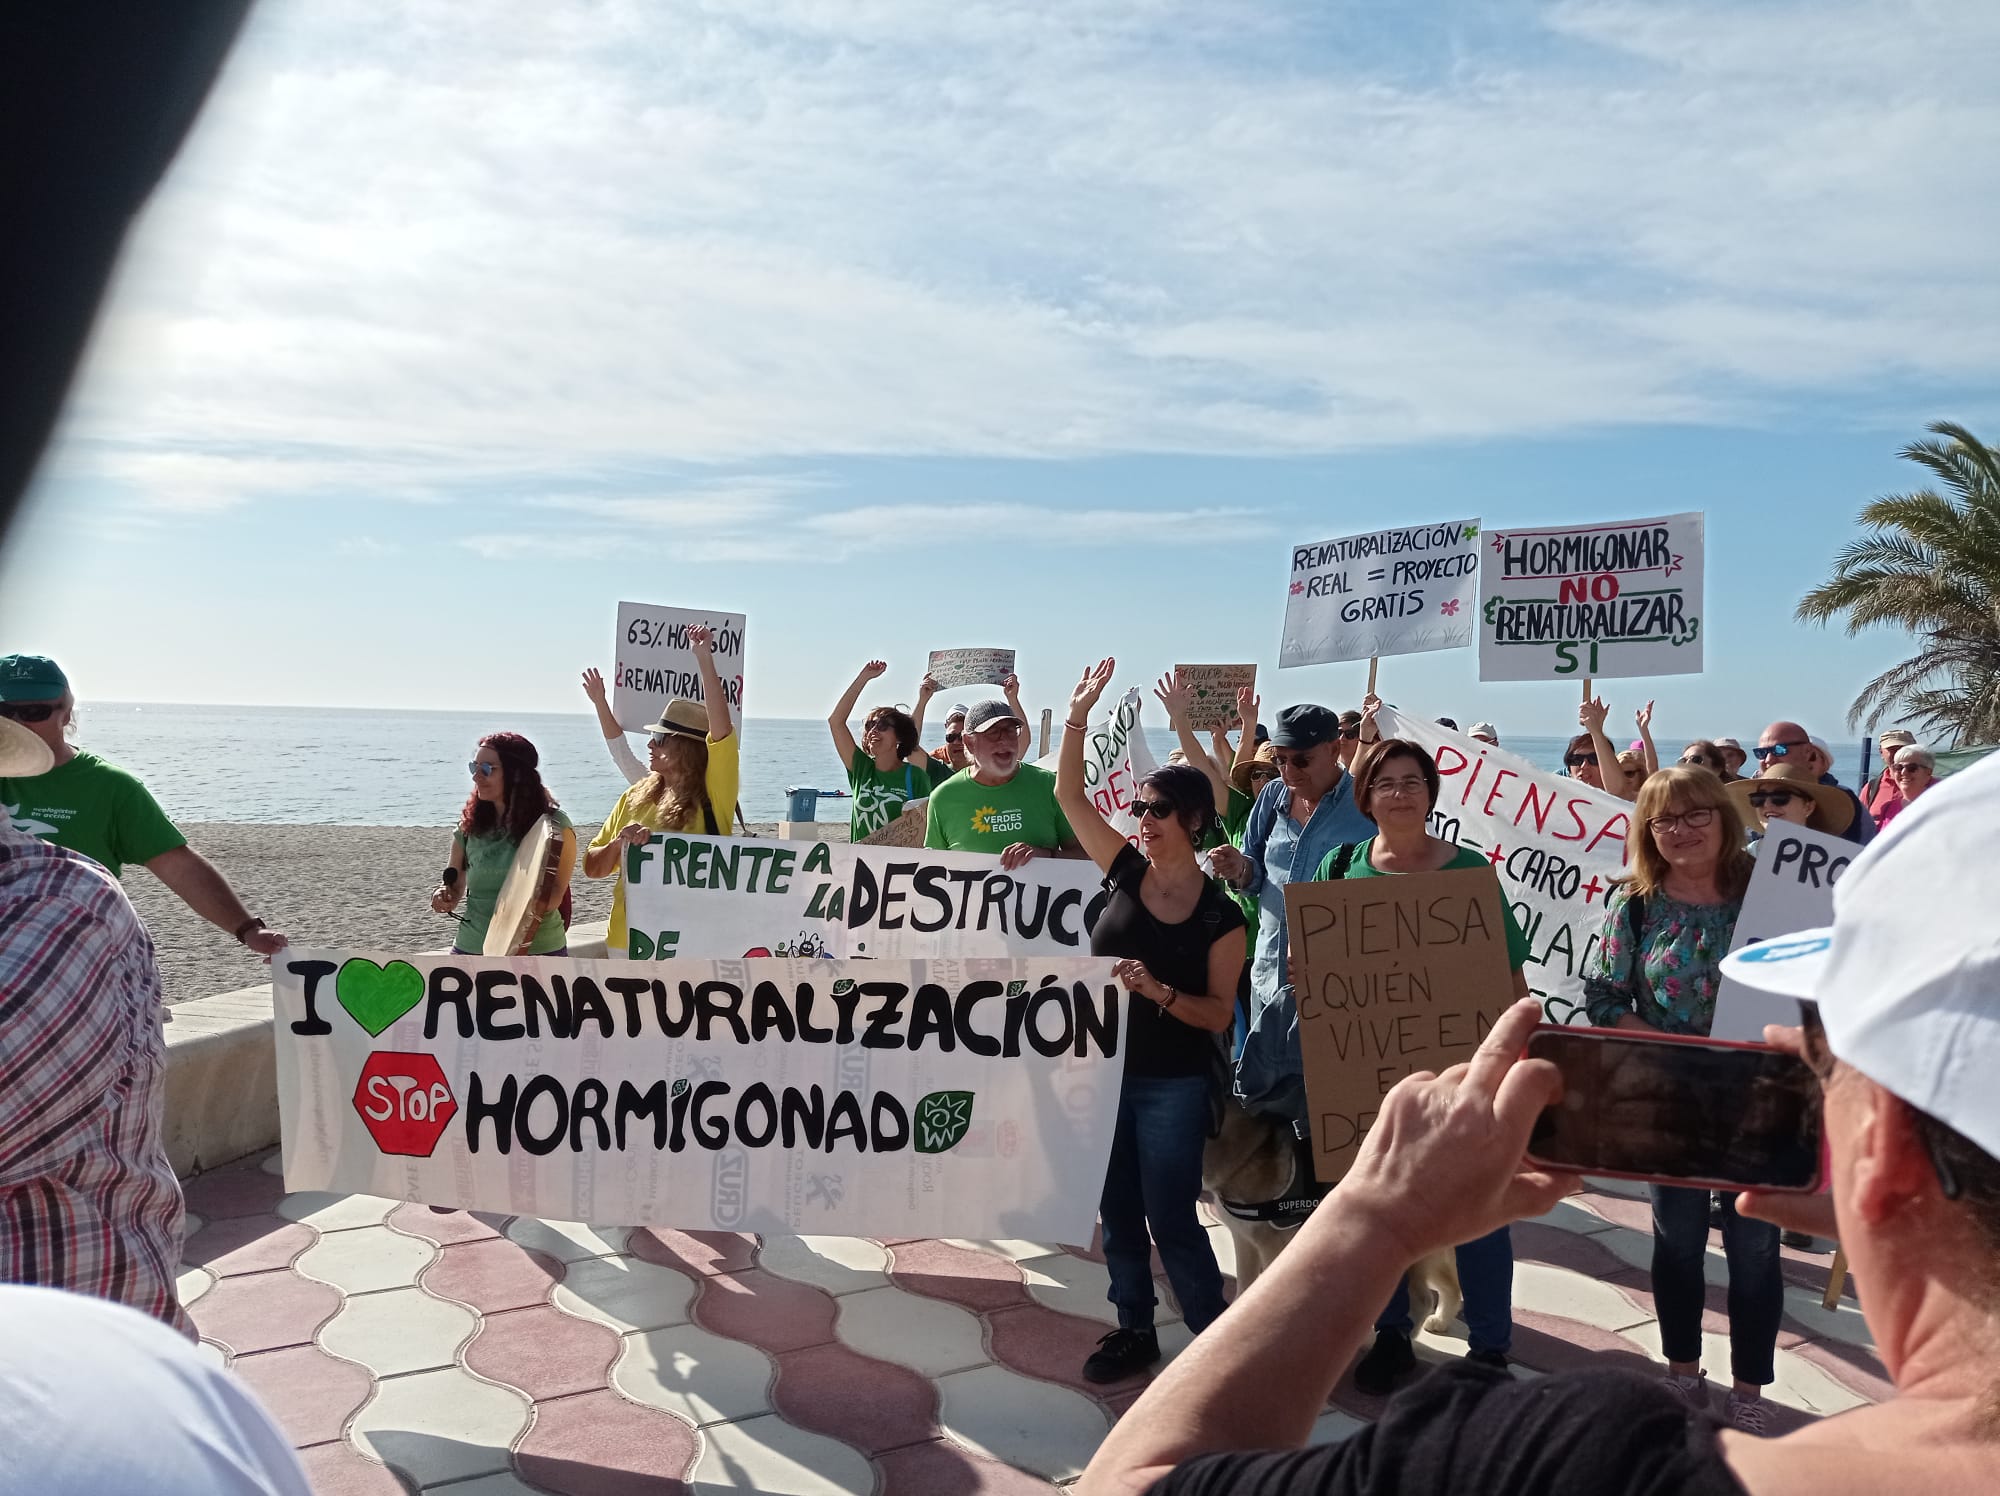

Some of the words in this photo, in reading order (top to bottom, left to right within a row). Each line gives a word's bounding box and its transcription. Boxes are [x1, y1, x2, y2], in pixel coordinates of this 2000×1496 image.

[1503, 528, 1671, 576] HORMIGONAR
[1307, 571, 1353, 598] REAL
[1392, 552, 1478, 586] PROYECTO
[1558, 573, 1620, 604] NO
[627, 619, 666, 648] 63%
[1495, 593, 1688, 640] RENATURALIZAR
[1553, 637, 1600, 674] SÍ
[983, 813, 1022, 824] VERDES
[992, 822, 1022, 833] EQUO
[627, 835, 797, 894] FRENTE
[802, 842, 833, 876] A
[803, 883, 846, 922] LA
[286, 960, 338, 1036] I
[1300, 961, 1433, 1021] ¿QUIÉN
[364, 1074, 453, 1122] STOP
